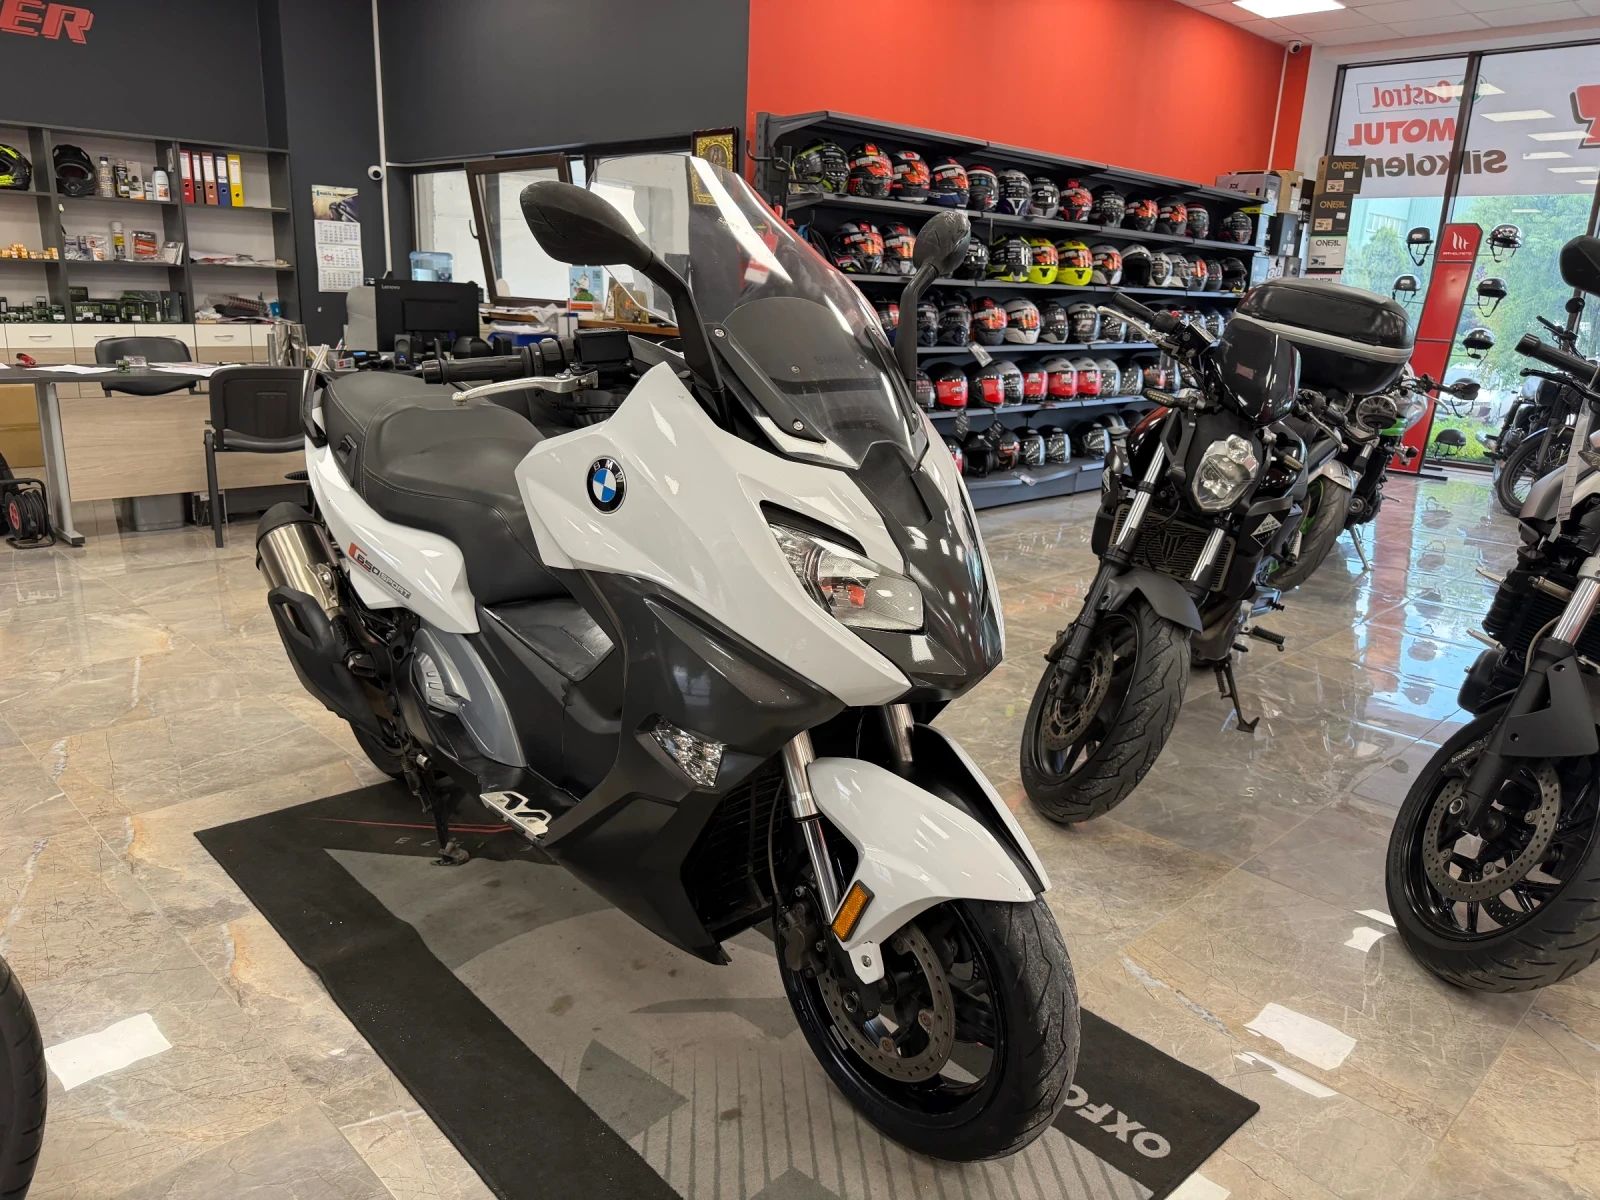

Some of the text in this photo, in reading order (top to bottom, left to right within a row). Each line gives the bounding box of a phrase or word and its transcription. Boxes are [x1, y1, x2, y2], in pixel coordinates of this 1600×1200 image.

[0, 0, 94, 44] ER
[592, 459, 624, 483] BMW
[380, 572, 412, 600] SPORT
[1451, 746, 1476, 763] brembo
